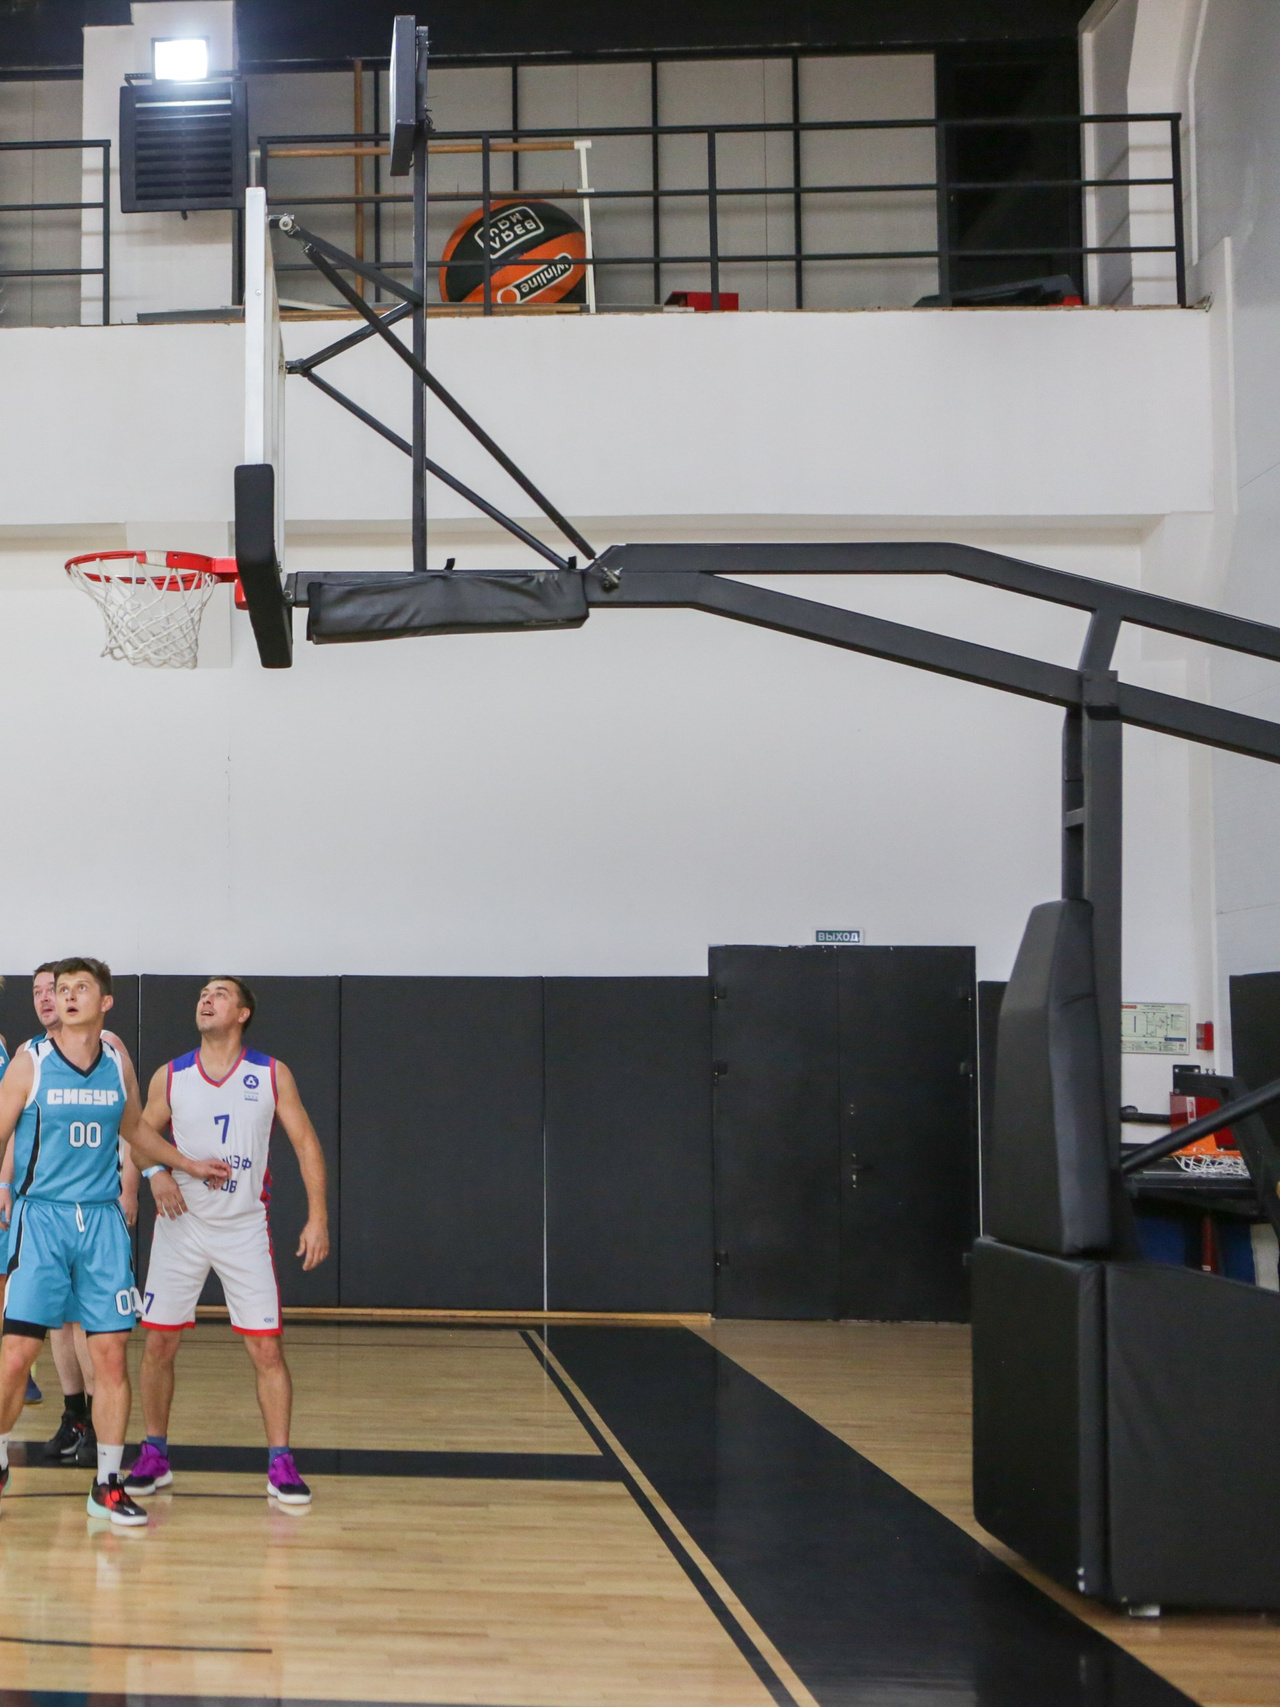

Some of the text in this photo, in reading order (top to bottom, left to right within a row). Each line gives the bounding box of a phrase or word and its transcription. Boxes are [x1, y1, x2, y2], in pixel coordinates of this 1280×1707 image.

[818, 932, 859, 942] ВЫХОД
[47, 1088, 119, 1106] СИБУР
[69, 1121, 102, 1148] 00
[214, 1114, 230, 1144] 7
[145, 1291, 155, 1315] 7
